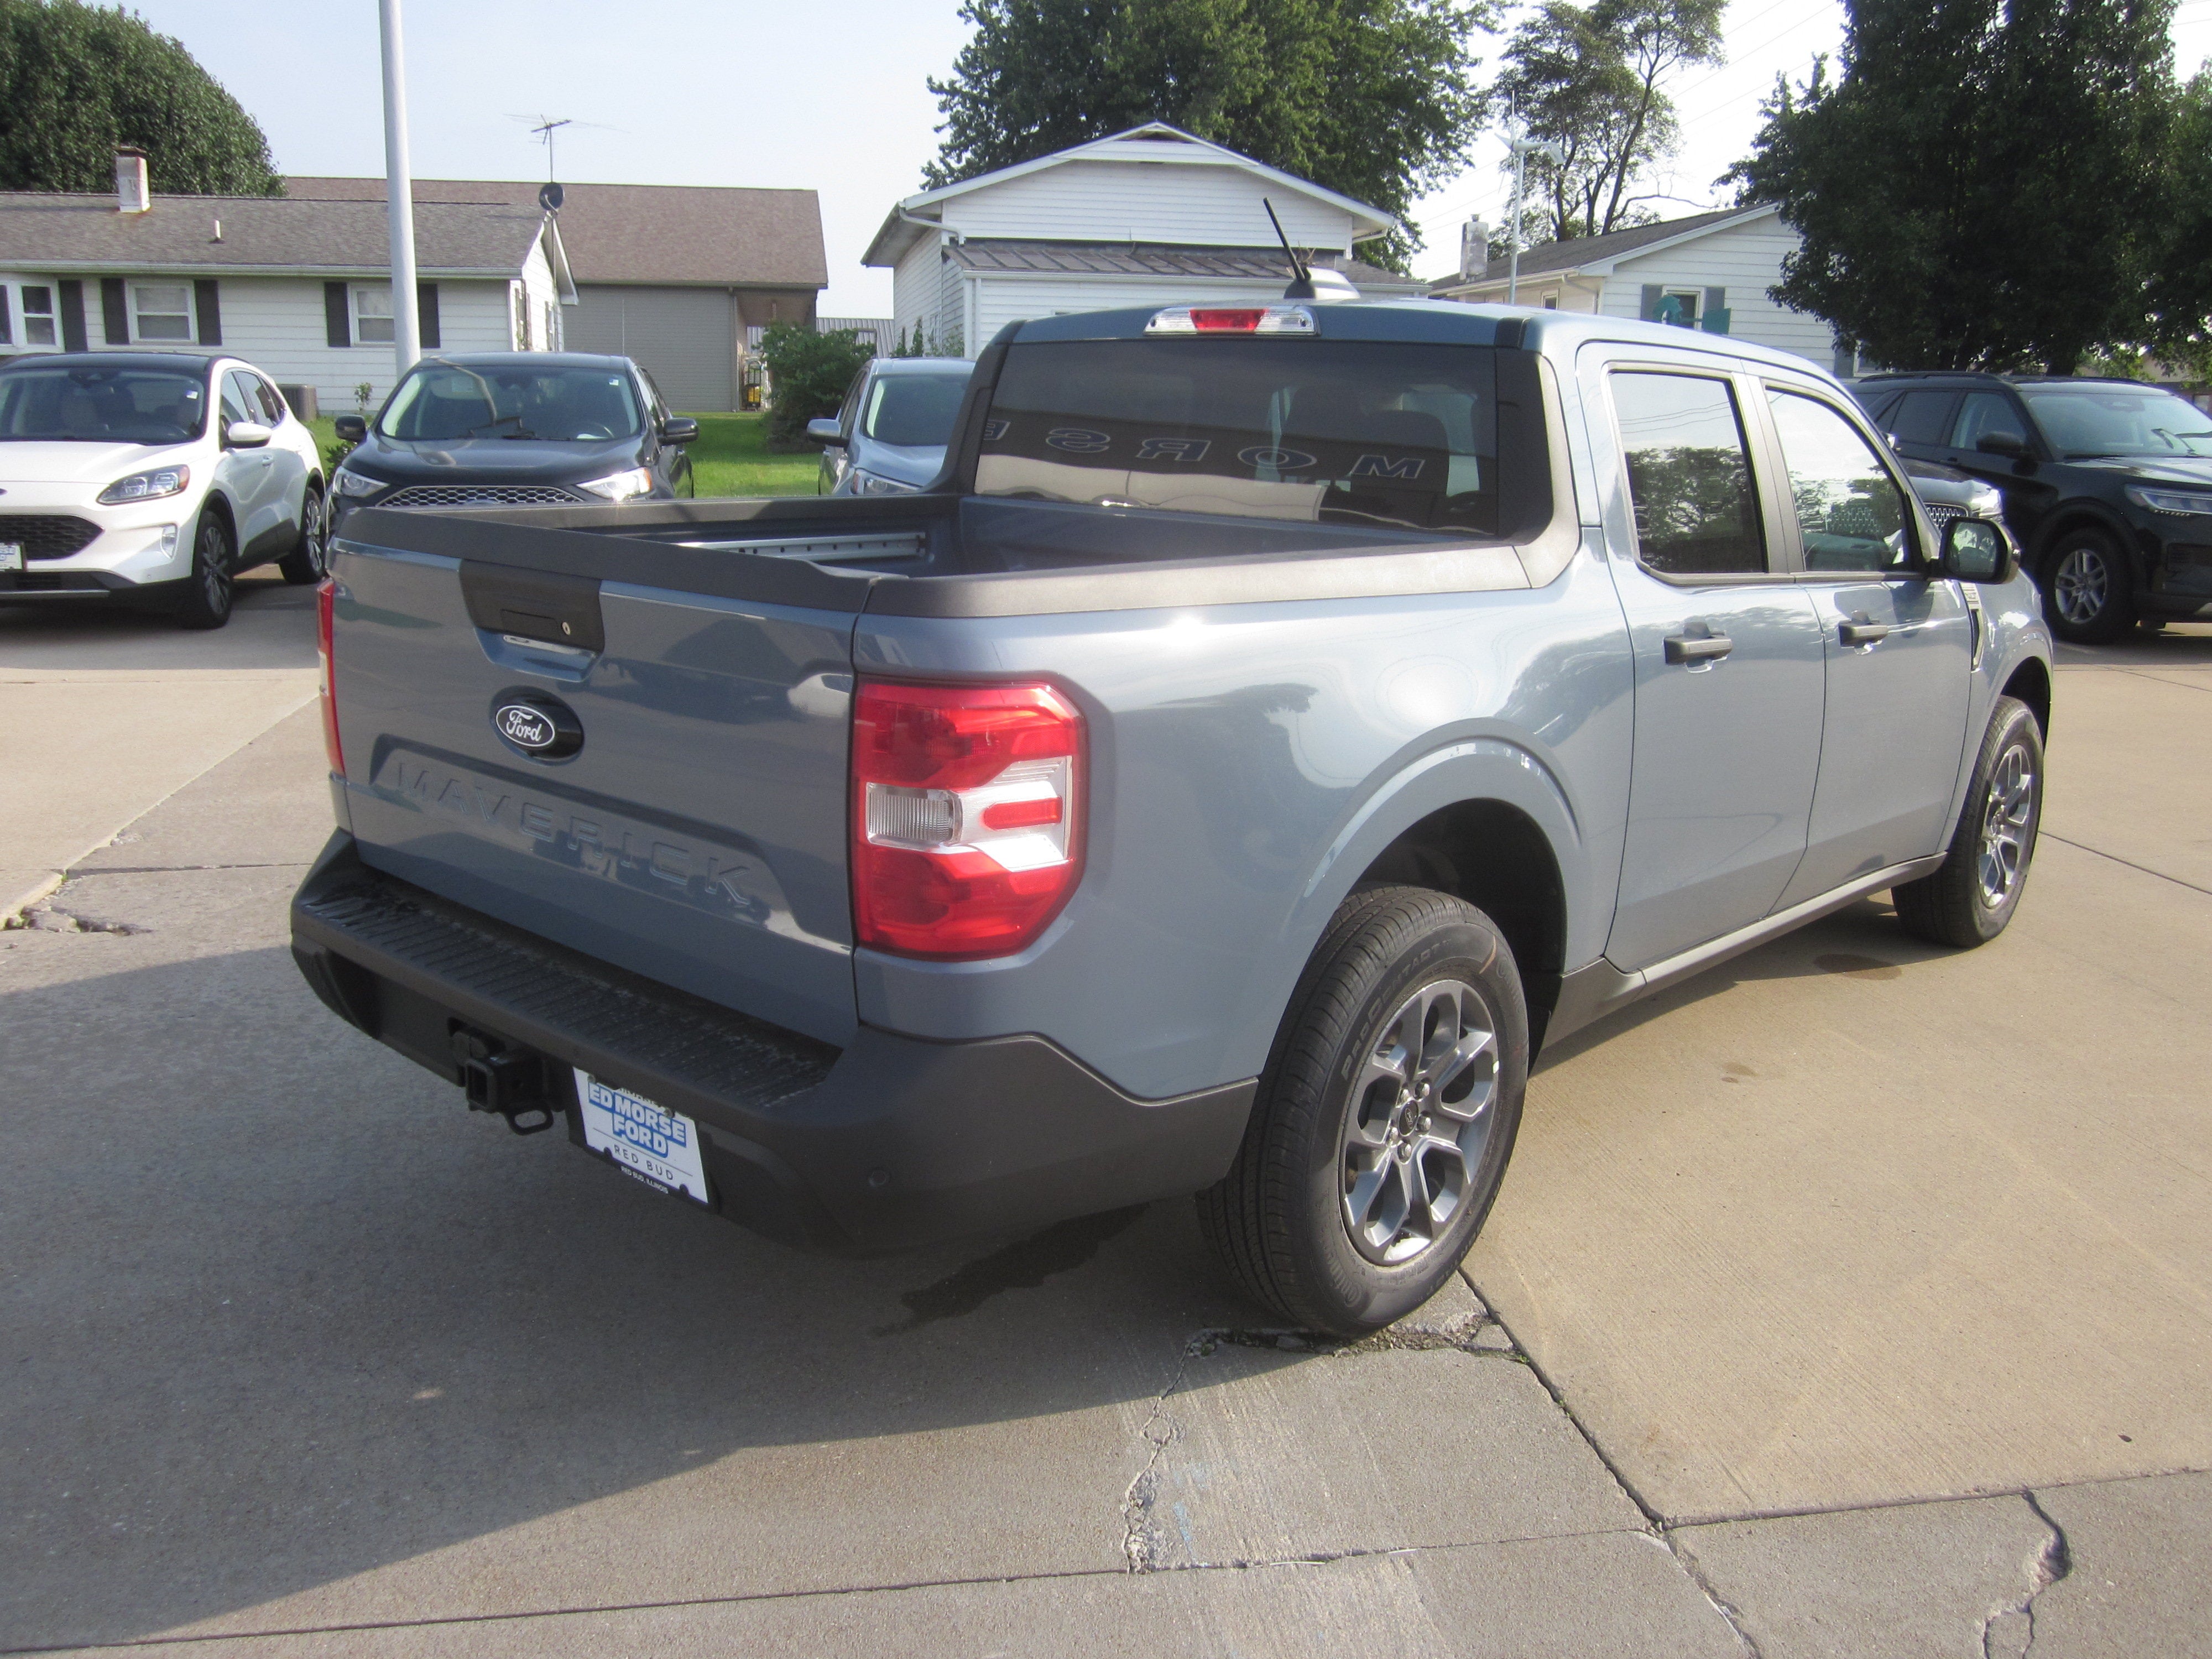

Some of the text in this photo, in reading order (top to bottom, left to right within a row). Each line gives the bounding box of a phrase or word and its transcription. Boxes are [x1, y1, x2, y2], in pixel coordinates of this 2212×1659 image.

[506, 709, 542, 742] Ford
[398, 763, 751, 905] MAVERICK
[588, 1082, 613, 1110] ED
[614, 1093, 686, 1145] MORSE
[613, 1114, 667, 1156] FORD
[614, 1144, 674, 1181] RED BUD
